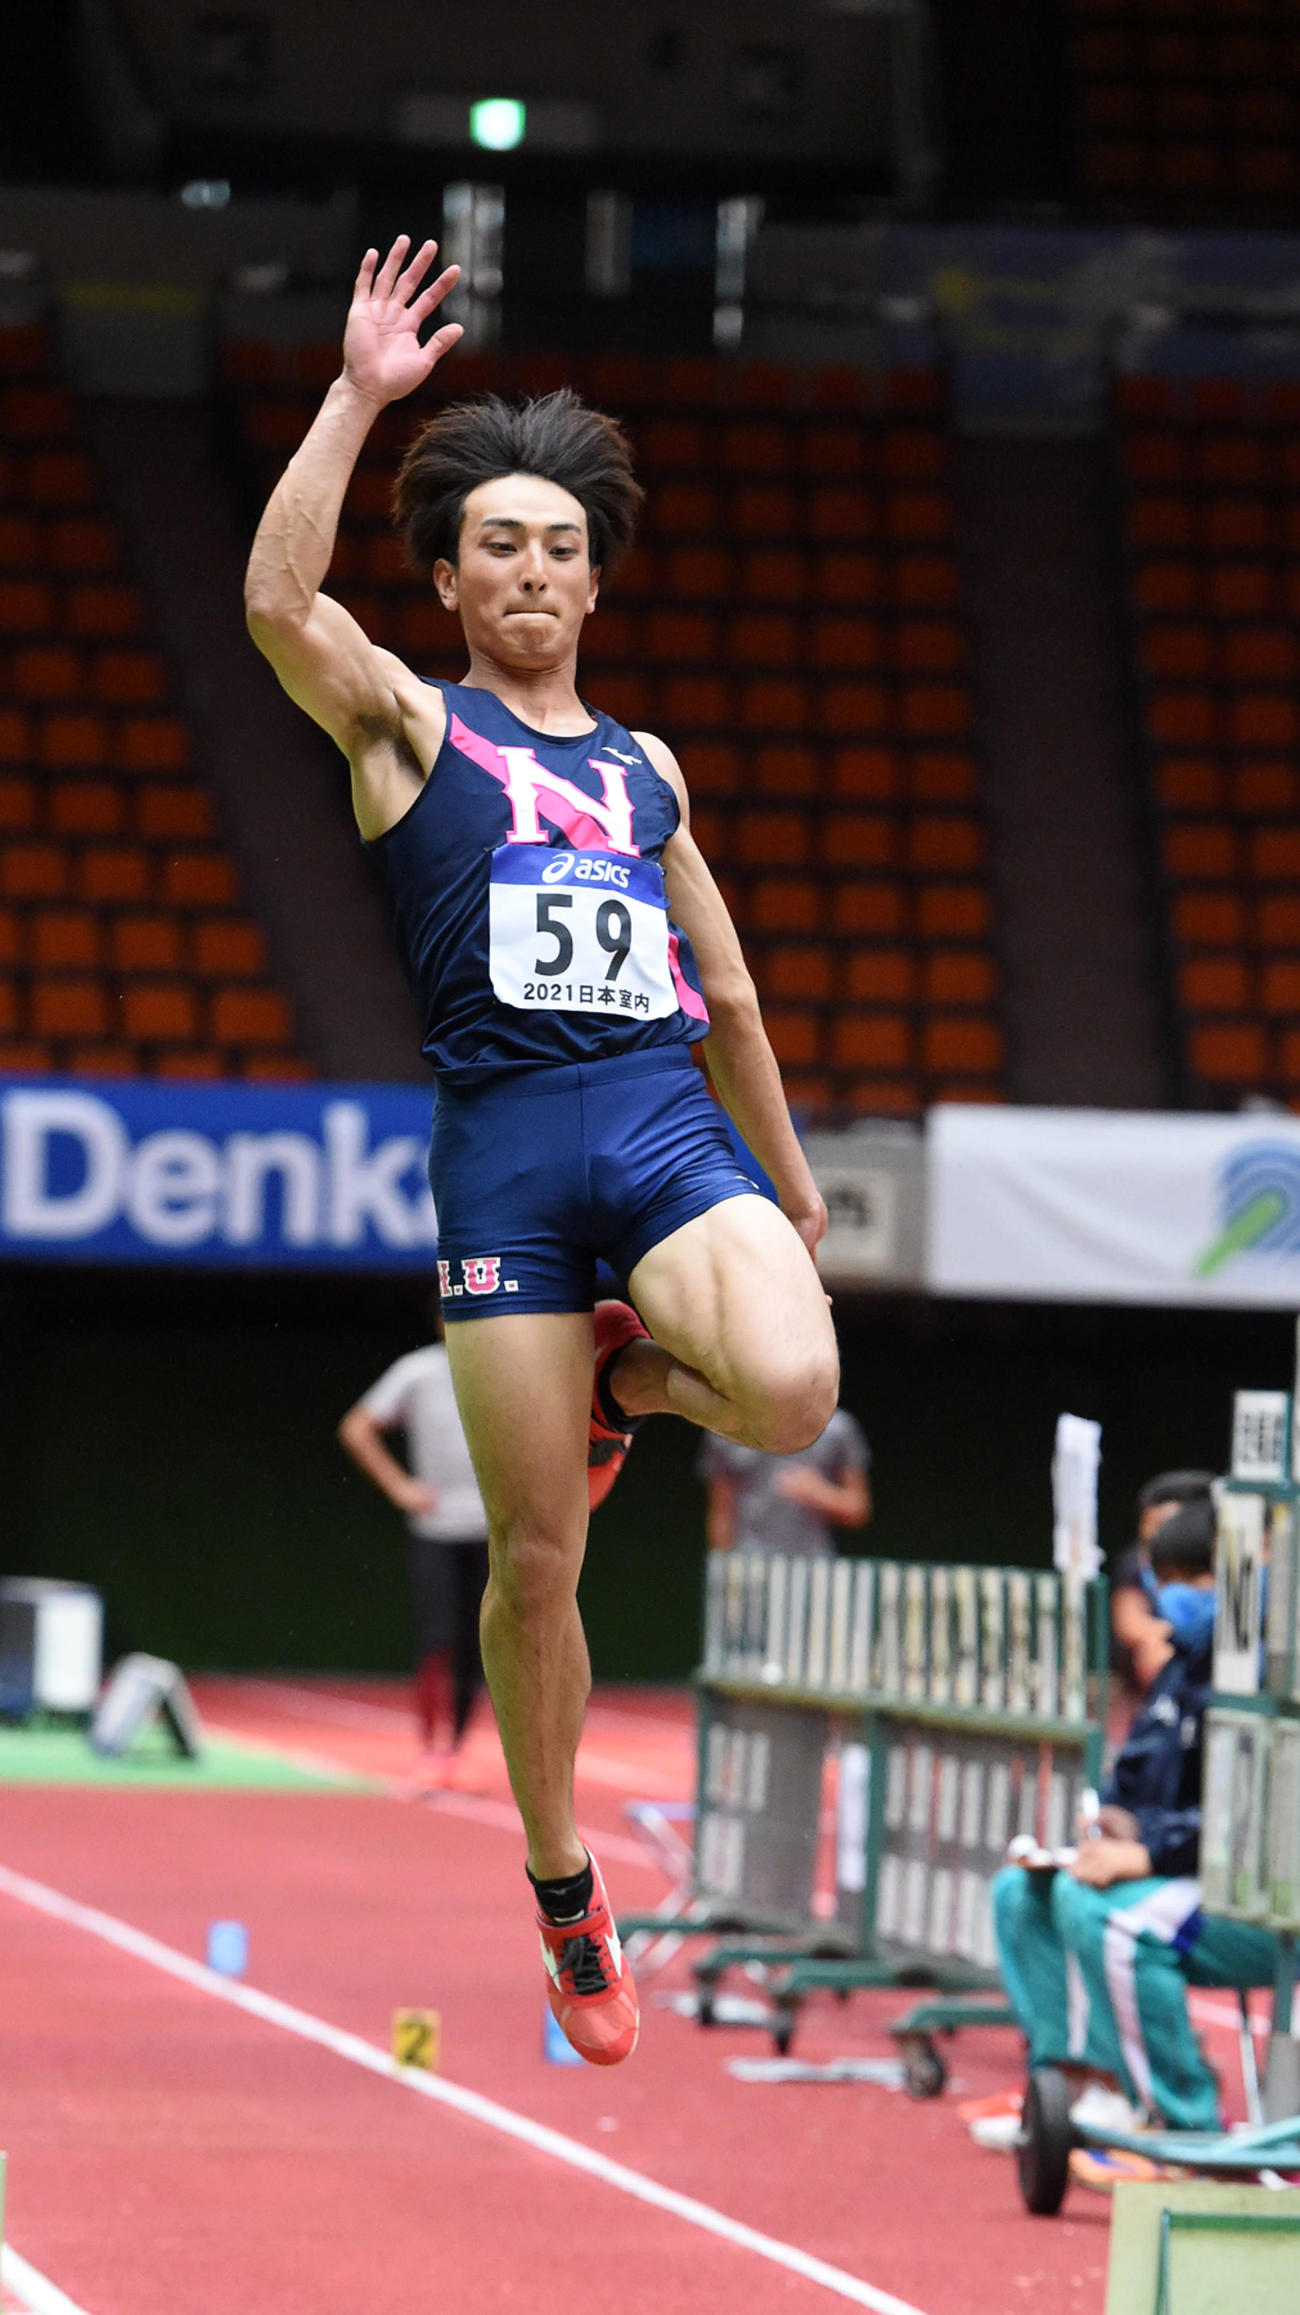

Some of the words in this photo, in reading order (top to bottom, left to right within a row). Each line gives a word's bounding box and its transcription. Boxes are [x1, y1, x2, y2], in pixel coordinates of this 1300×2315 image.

[496, 745, 641, 859] N
[575, 858, 630, 888] asics
[534, 893, 632, 982] 59
[523, 983, 649, 1013] 2021日本室内
[402, 2016, 432, 2068] 2
